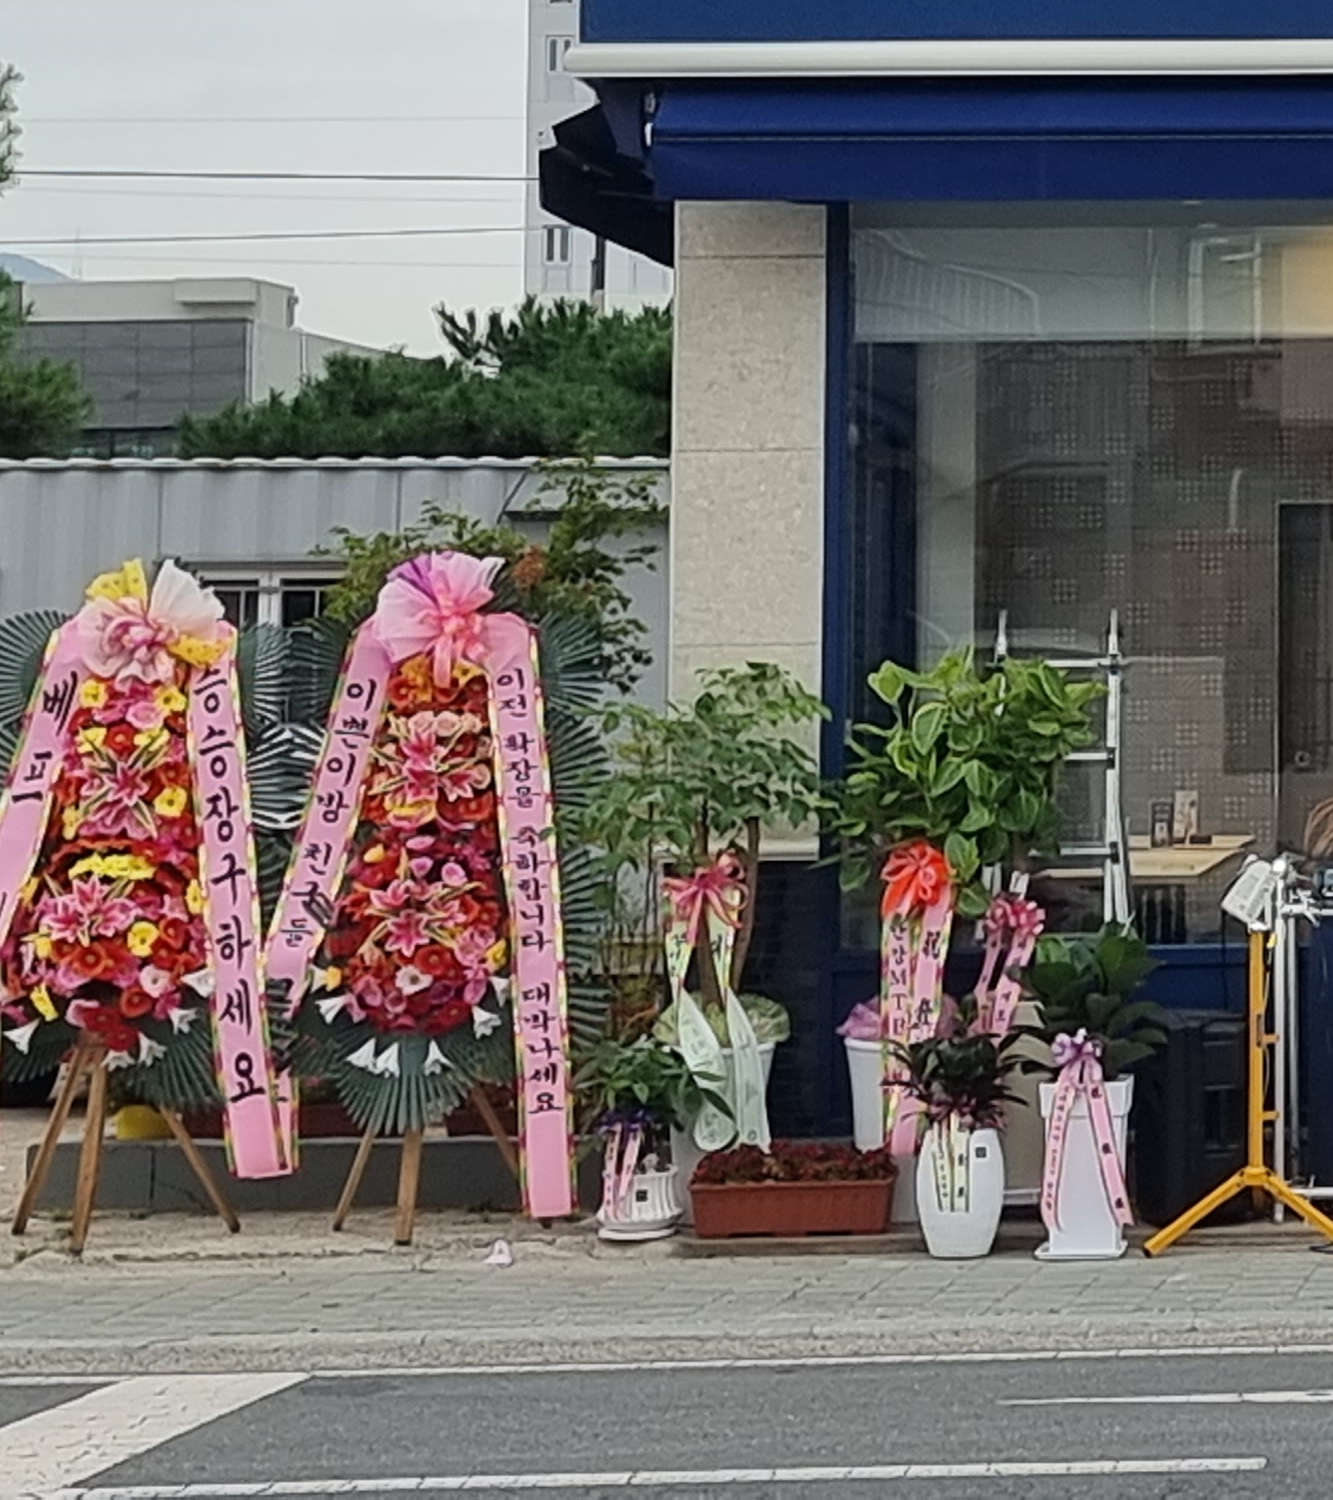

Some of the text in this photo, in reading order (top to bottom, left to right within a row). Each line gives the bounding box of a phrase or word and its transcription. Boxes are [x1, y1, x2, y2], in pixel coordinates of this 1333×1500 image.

[192, 667, 266, 1104] 승승장구하세요
[496, 667, 528, 718] 이전
[521, 981, 565, 1115] 대박나세요
